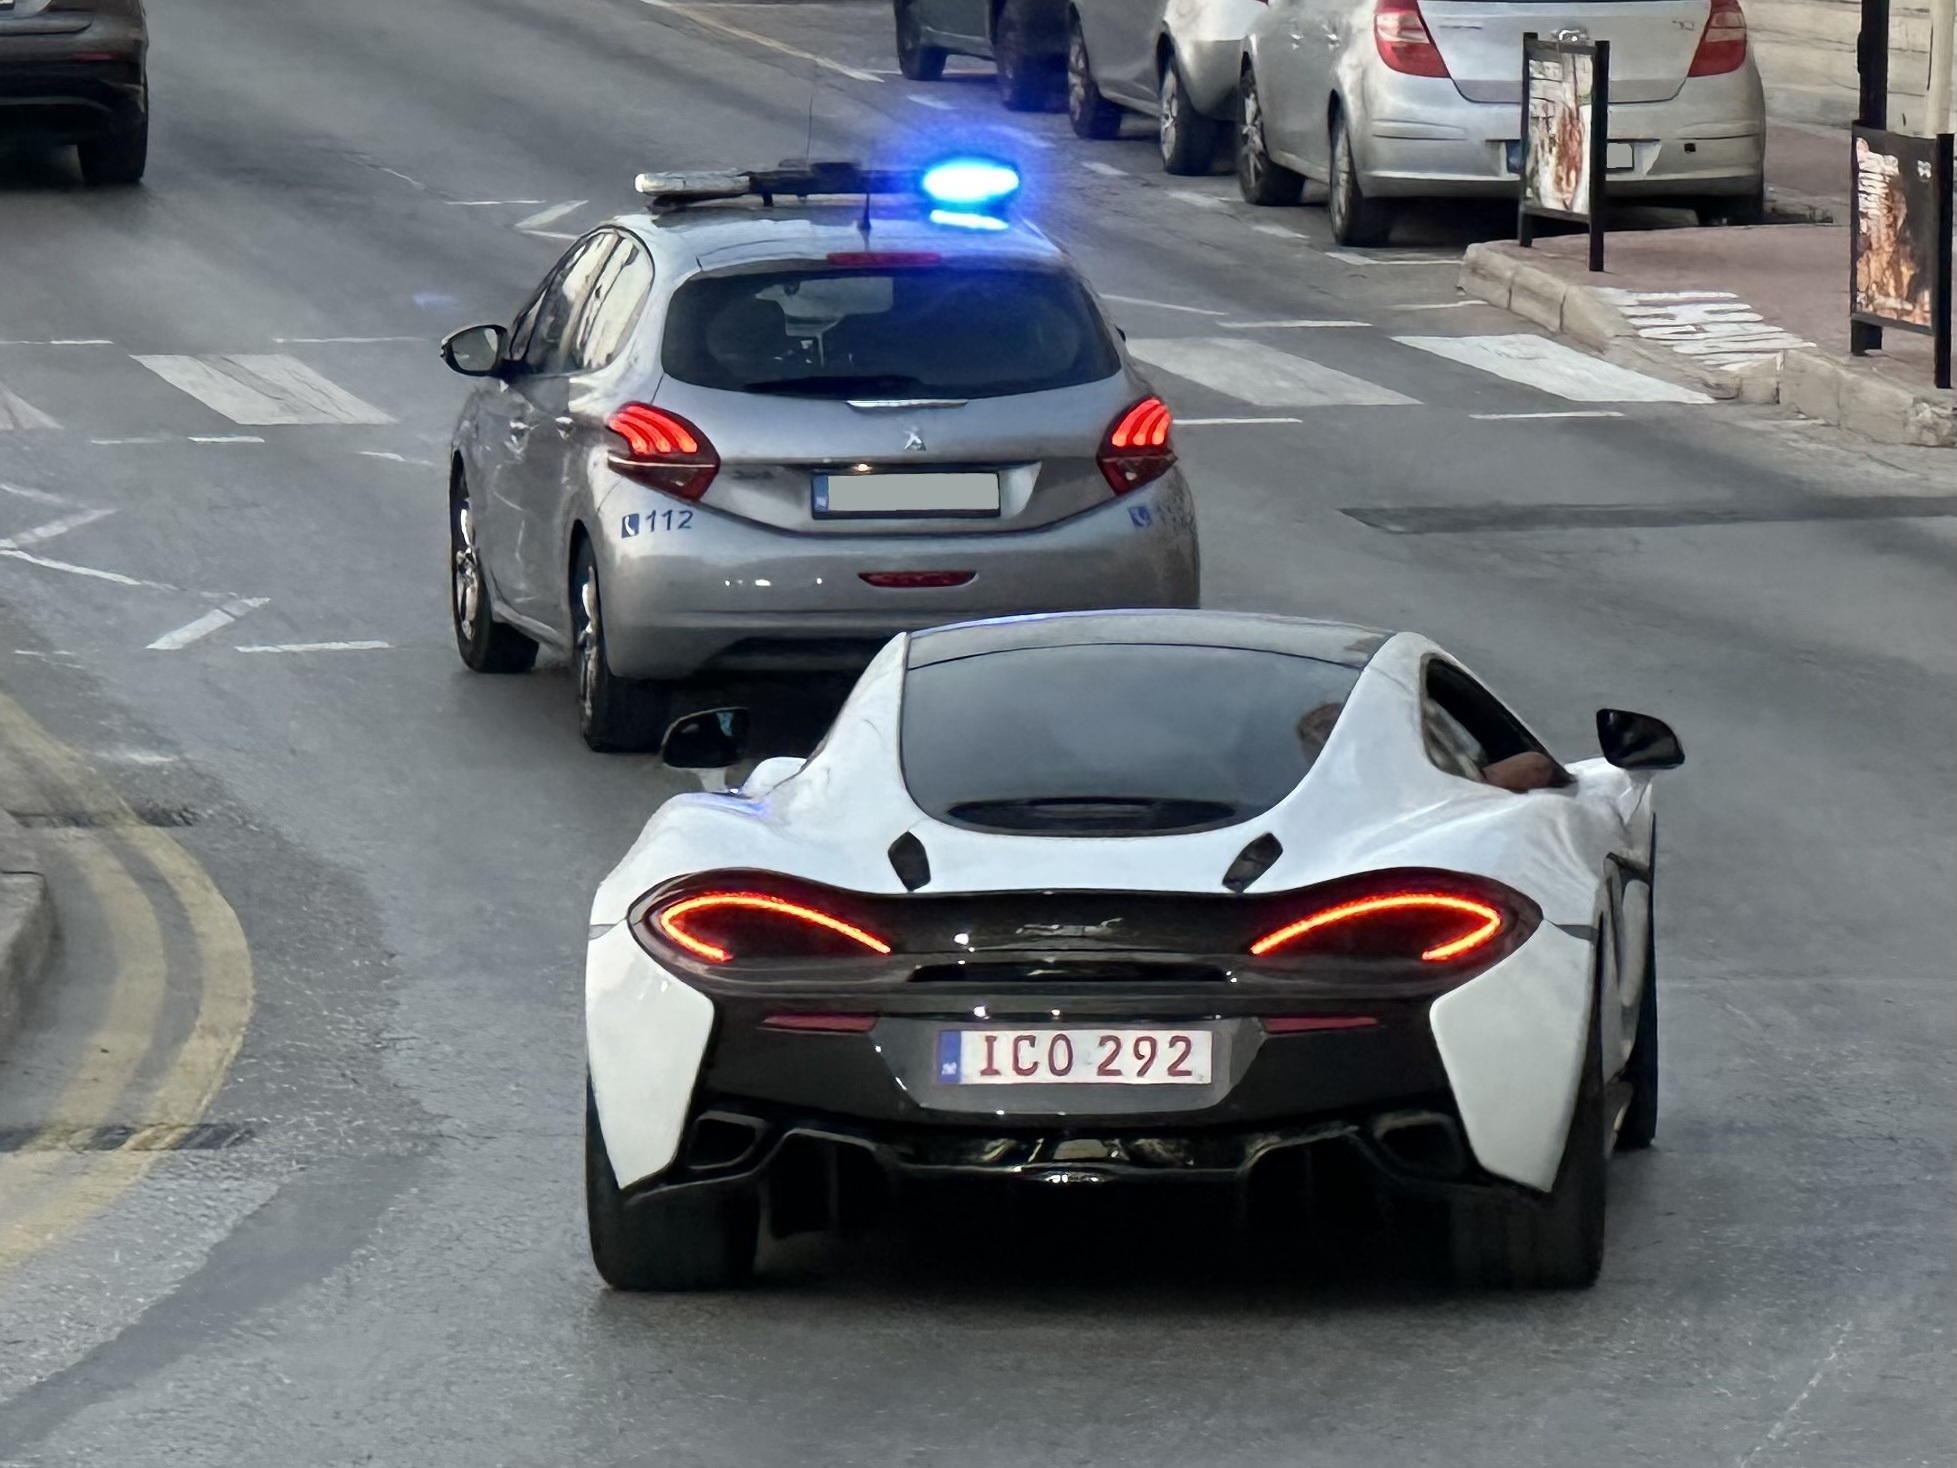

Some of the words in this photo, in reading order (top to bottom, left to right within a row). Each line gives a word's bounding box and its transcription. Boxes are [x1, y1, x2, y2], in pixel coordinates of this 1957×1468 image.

[646, 509, 693, 532] 112
[980, 1033, 1073, 1077] ICO
[1096, 1034, 1193, 1078] 292
